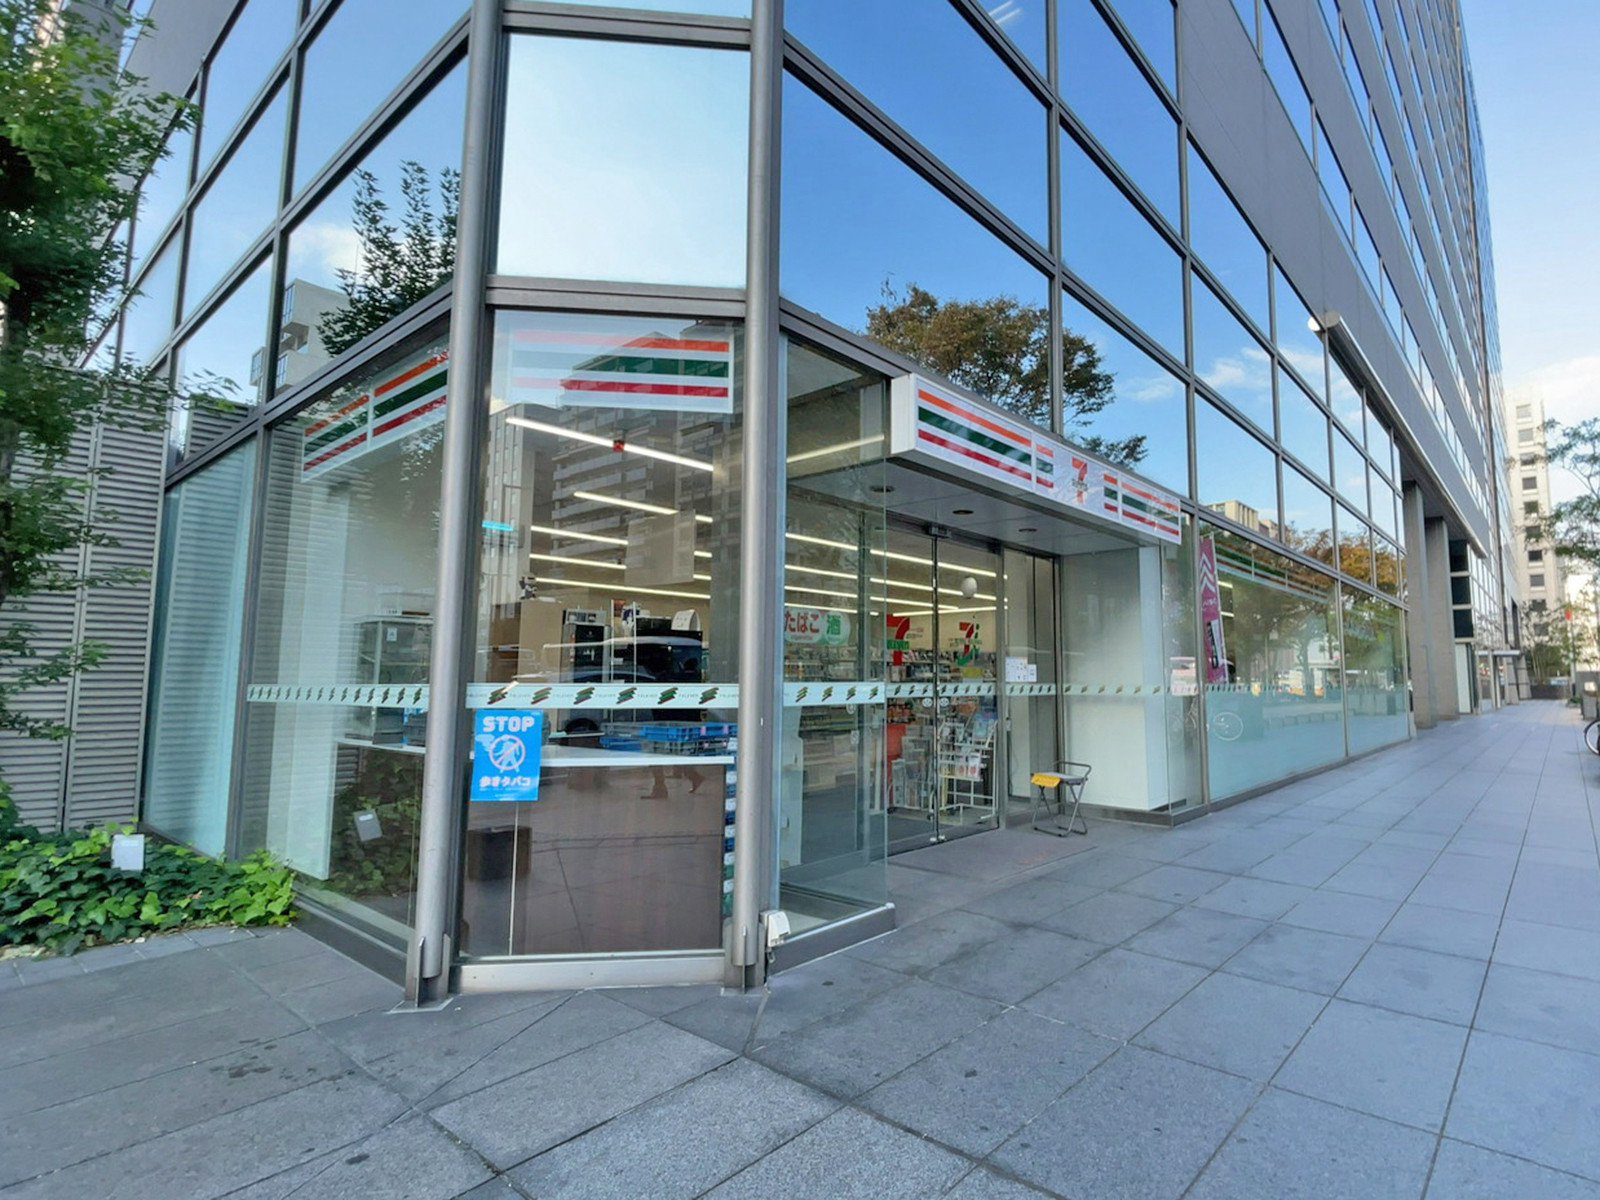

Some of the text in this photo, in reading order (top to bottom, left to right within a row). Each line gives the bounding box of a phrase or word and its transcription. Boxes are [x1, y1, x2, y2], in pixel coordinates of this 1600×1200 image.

[784, 610, 841, 635] たばこ 酒
[482, 716, 535, 732] STOP
